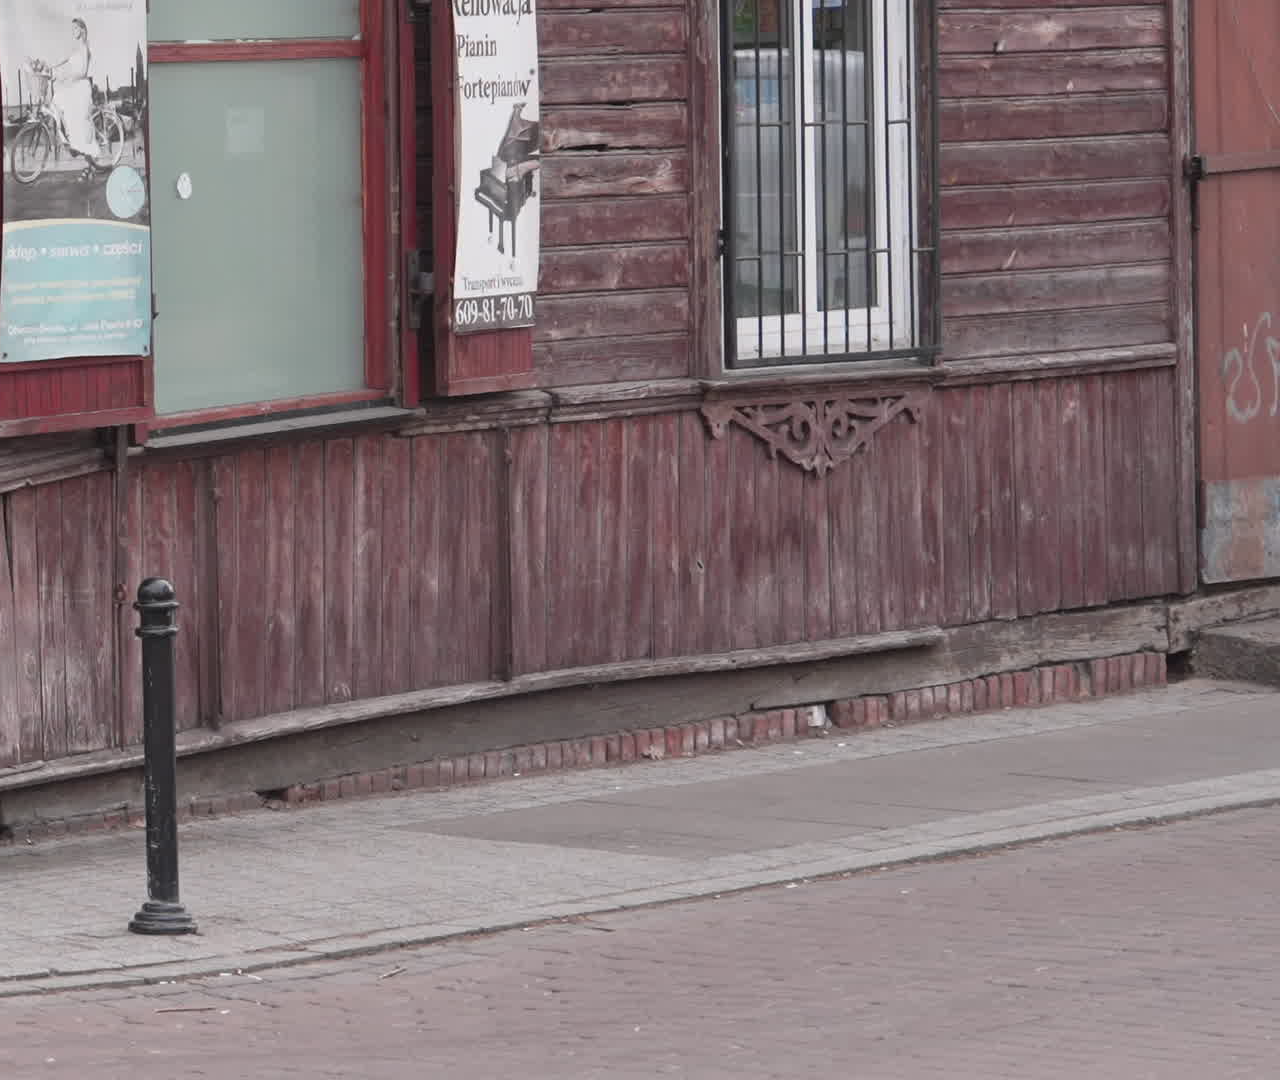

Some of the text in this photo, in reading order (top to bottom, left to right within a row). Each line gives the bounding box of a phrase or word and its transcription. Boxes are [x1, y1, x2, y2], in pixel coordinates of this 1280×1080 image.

[456, 33, 497, 57] Pianin
[455, 72, 531, 104] Fortepianów
[455, 294, 533, 325] 609-81-70-70
